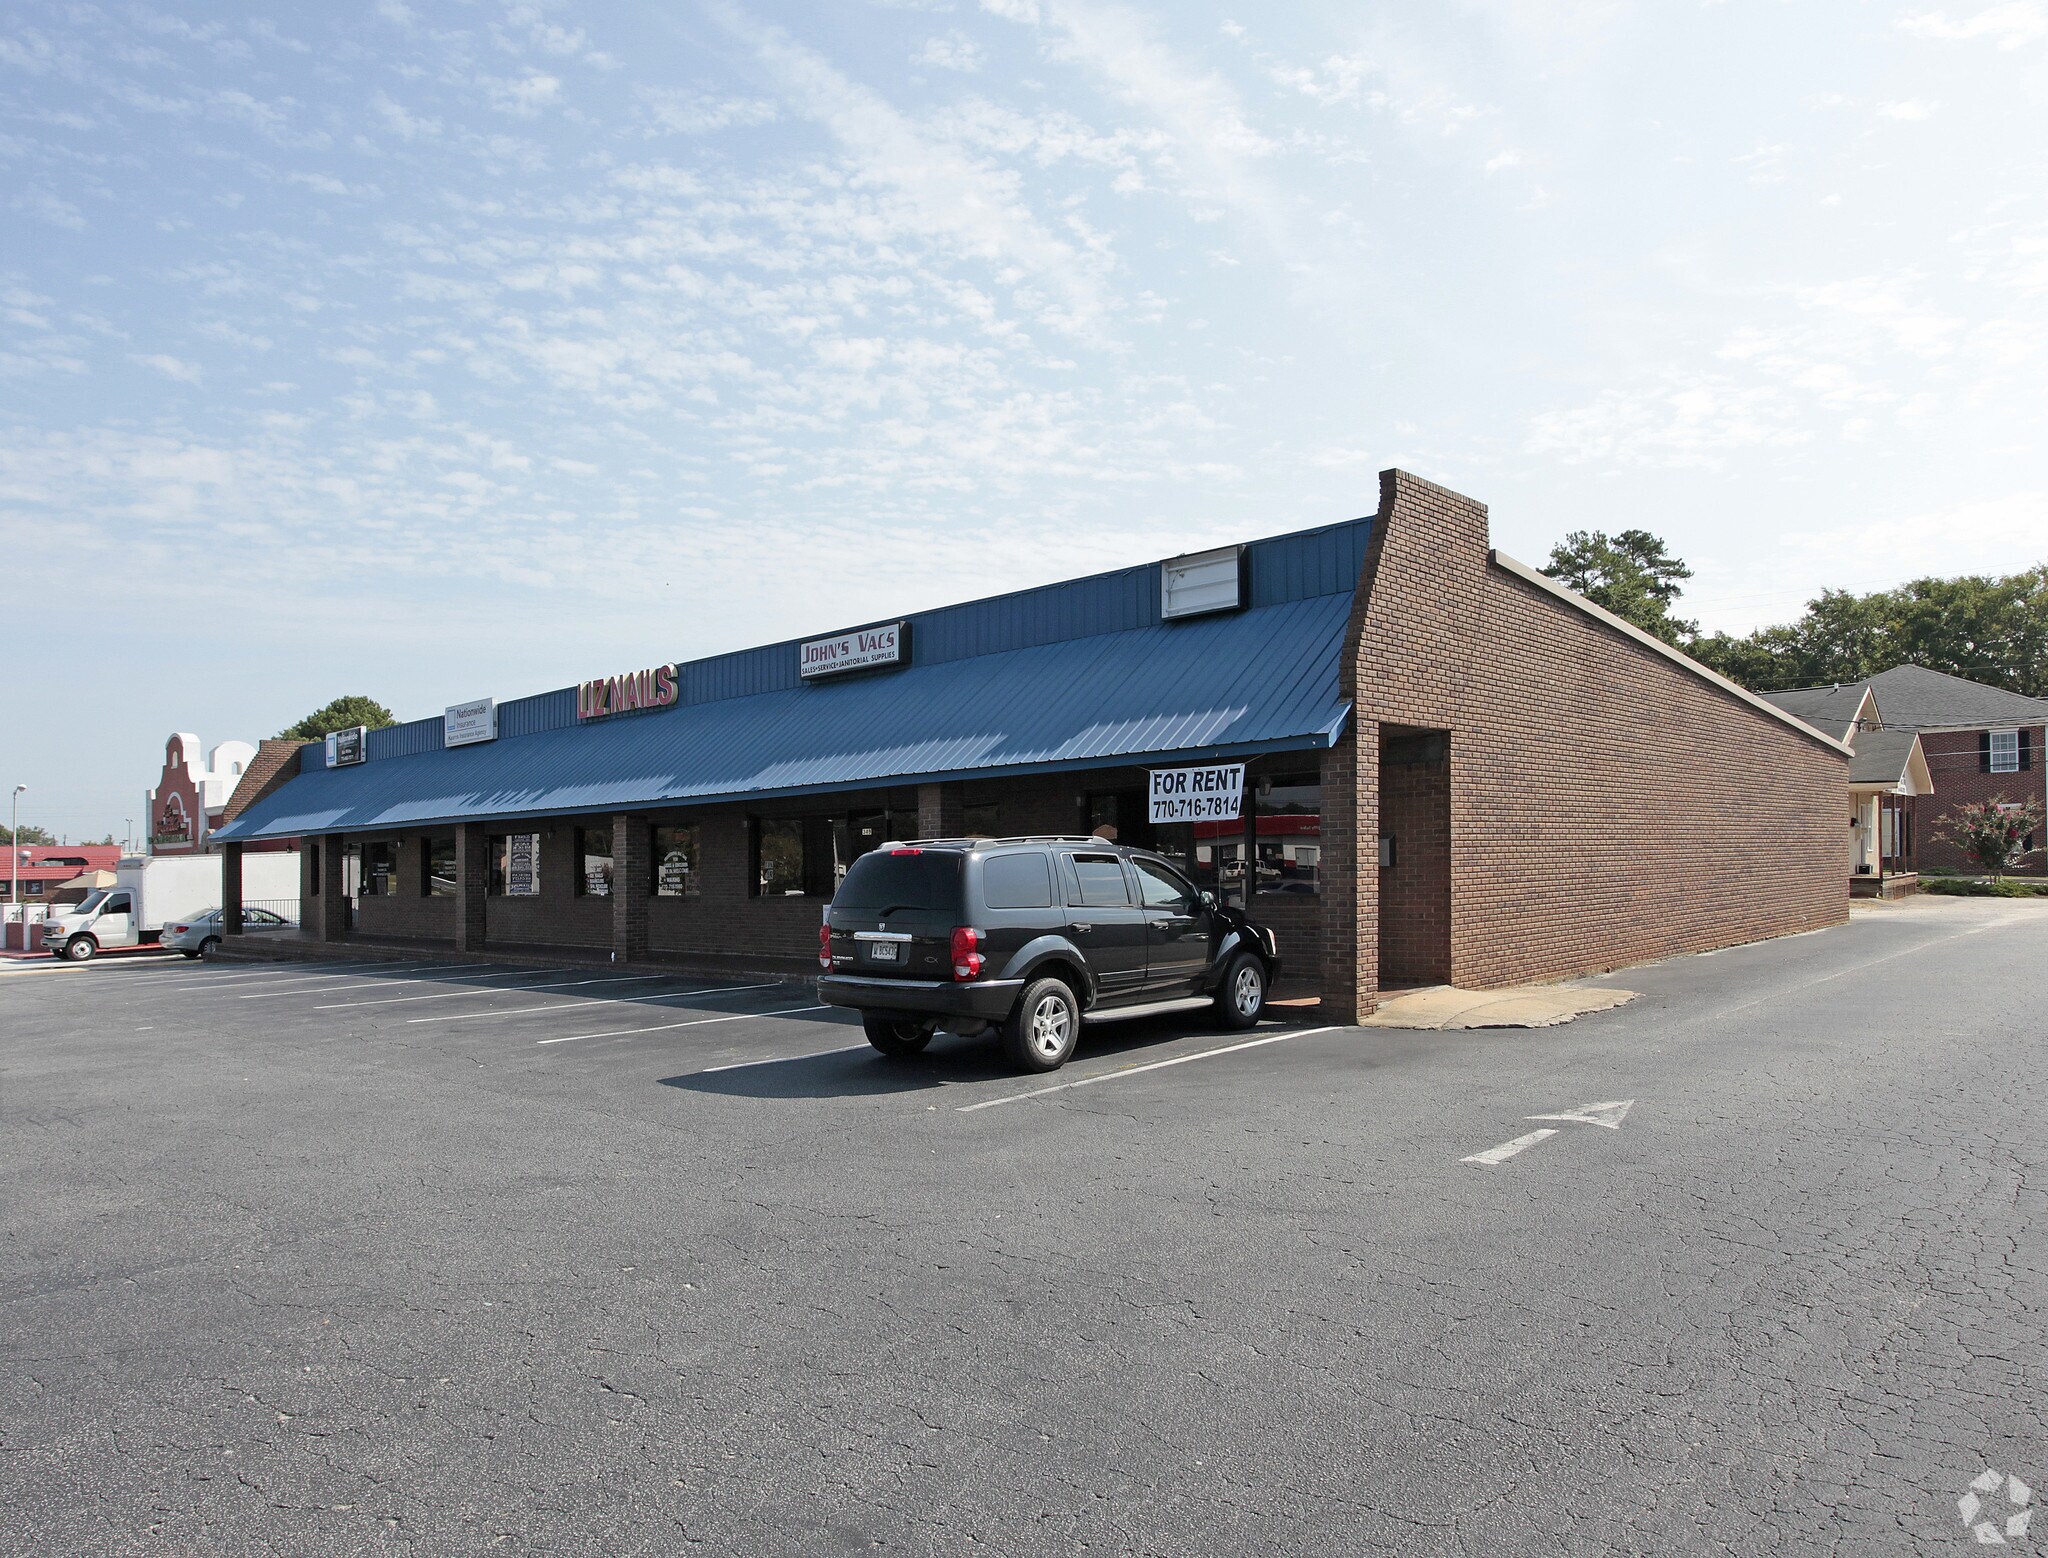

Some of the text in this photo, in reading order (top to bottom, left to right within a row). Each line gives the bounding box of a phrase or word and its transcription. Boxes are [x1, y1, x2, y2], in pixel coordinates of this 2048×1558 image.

[802, 631, 895, 665] JOHN'S VACS
[871, 650, 896, 662] SUPPLIES
[577, 664, 677, 719] LIZ NAILS
[456, 703, 487, 719] Nationwide
[456, 719, 476, 728] Insurance
[1153, 767, 1241, 795] FOR RENT
[1153, 795, 1239, 819] 770-716-7814
